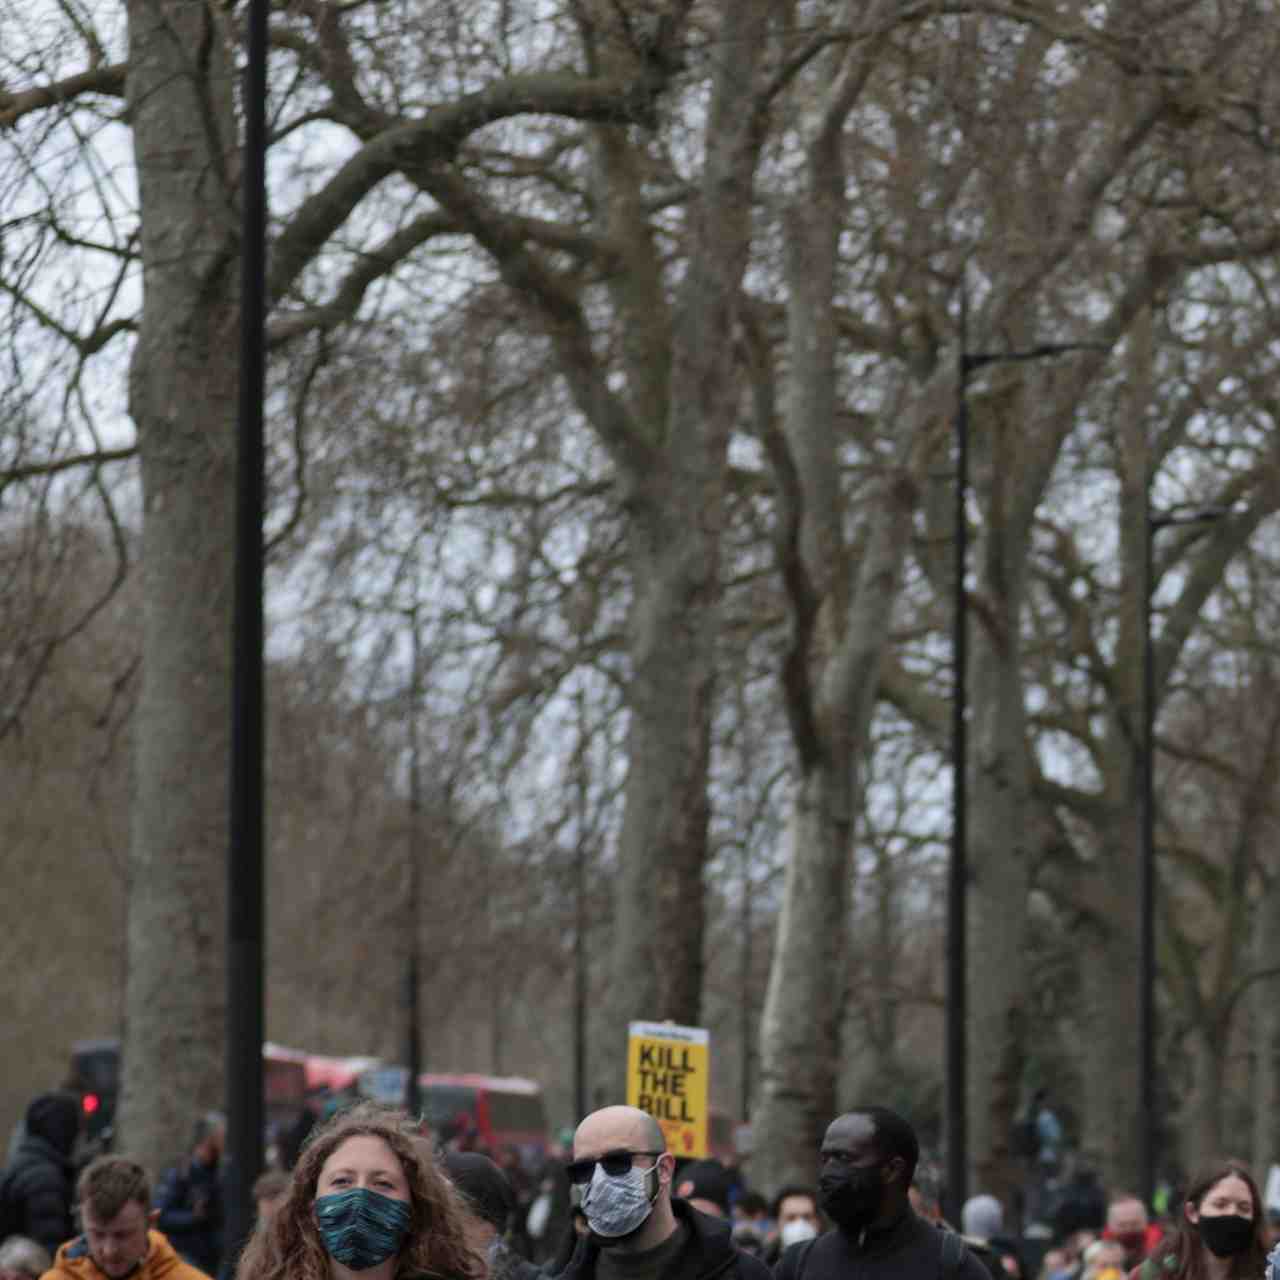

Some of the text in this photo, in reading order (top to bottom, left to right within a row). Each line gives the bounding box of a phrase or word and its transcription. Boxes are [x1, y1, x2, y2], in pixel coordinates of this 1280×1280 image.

[639, 1044, 696, 1072] KILL
[638, 1067, 687, 1096] THE
[638, 1095, 695, 1122] BILL
